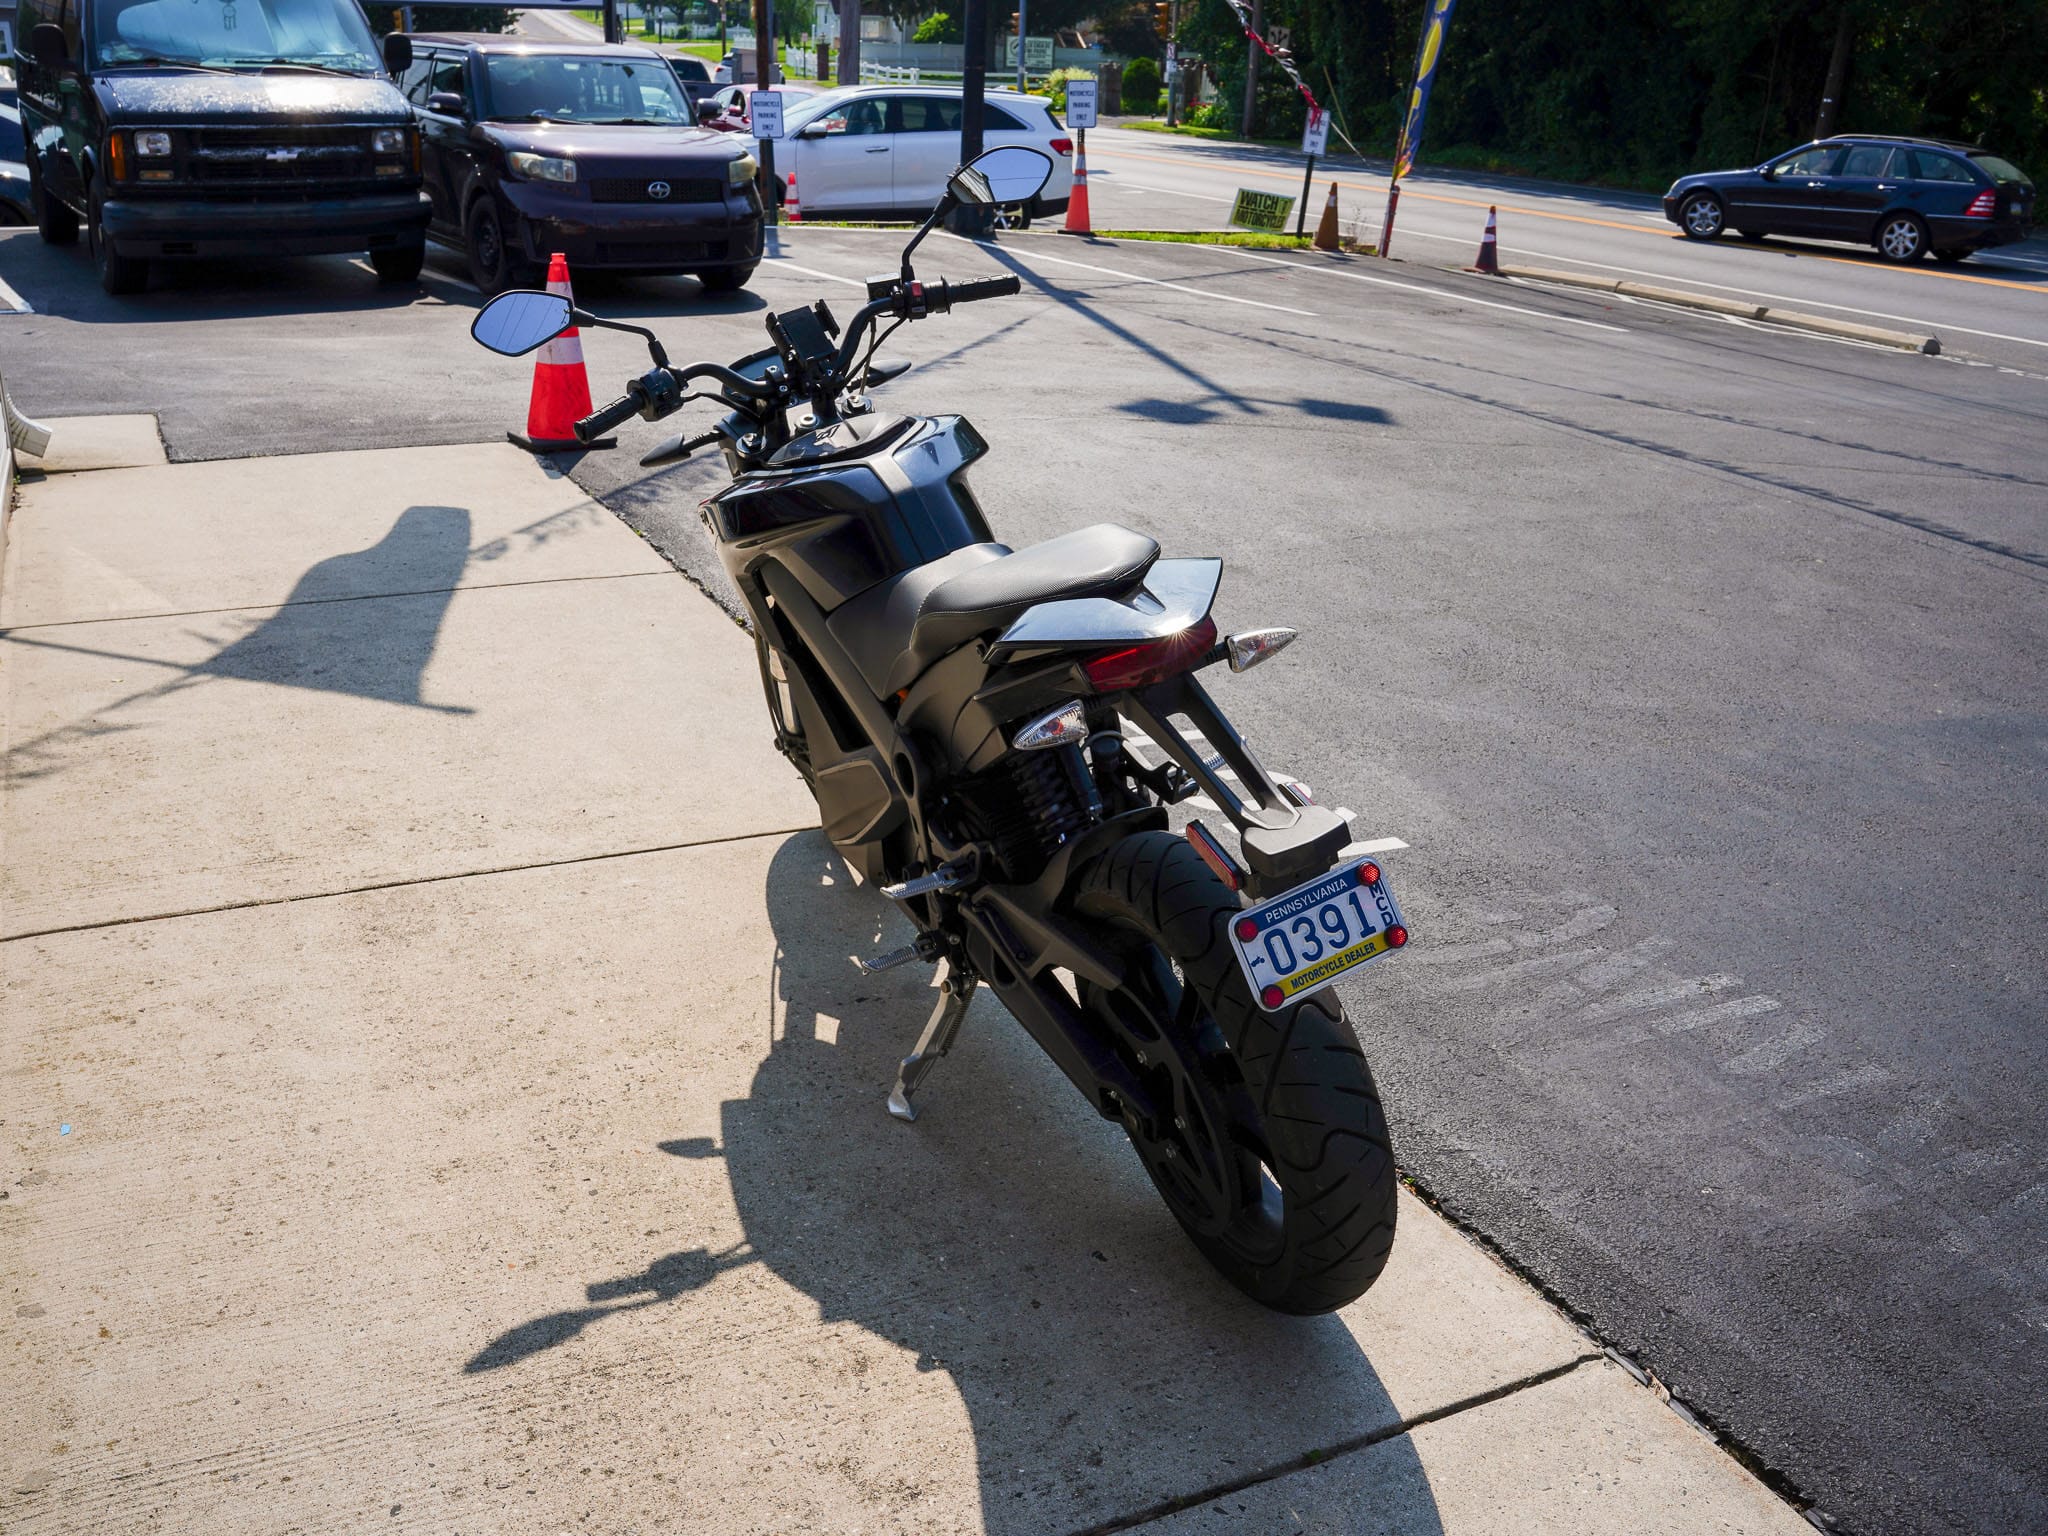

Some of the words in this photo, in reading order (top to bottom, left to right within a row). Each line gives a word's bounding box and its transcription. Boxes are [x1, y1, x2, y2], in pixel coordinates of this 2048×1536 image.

[1240, 191, 1279, 210] WATCH
[1265, 878, 1348, 923] PENNSYLVANIA
[1263, 892, 1377, 975] 0391
[1291, 959, 1345, 990] MOTORCYCLE
[1345, 942, 1376, 962] DEALER
